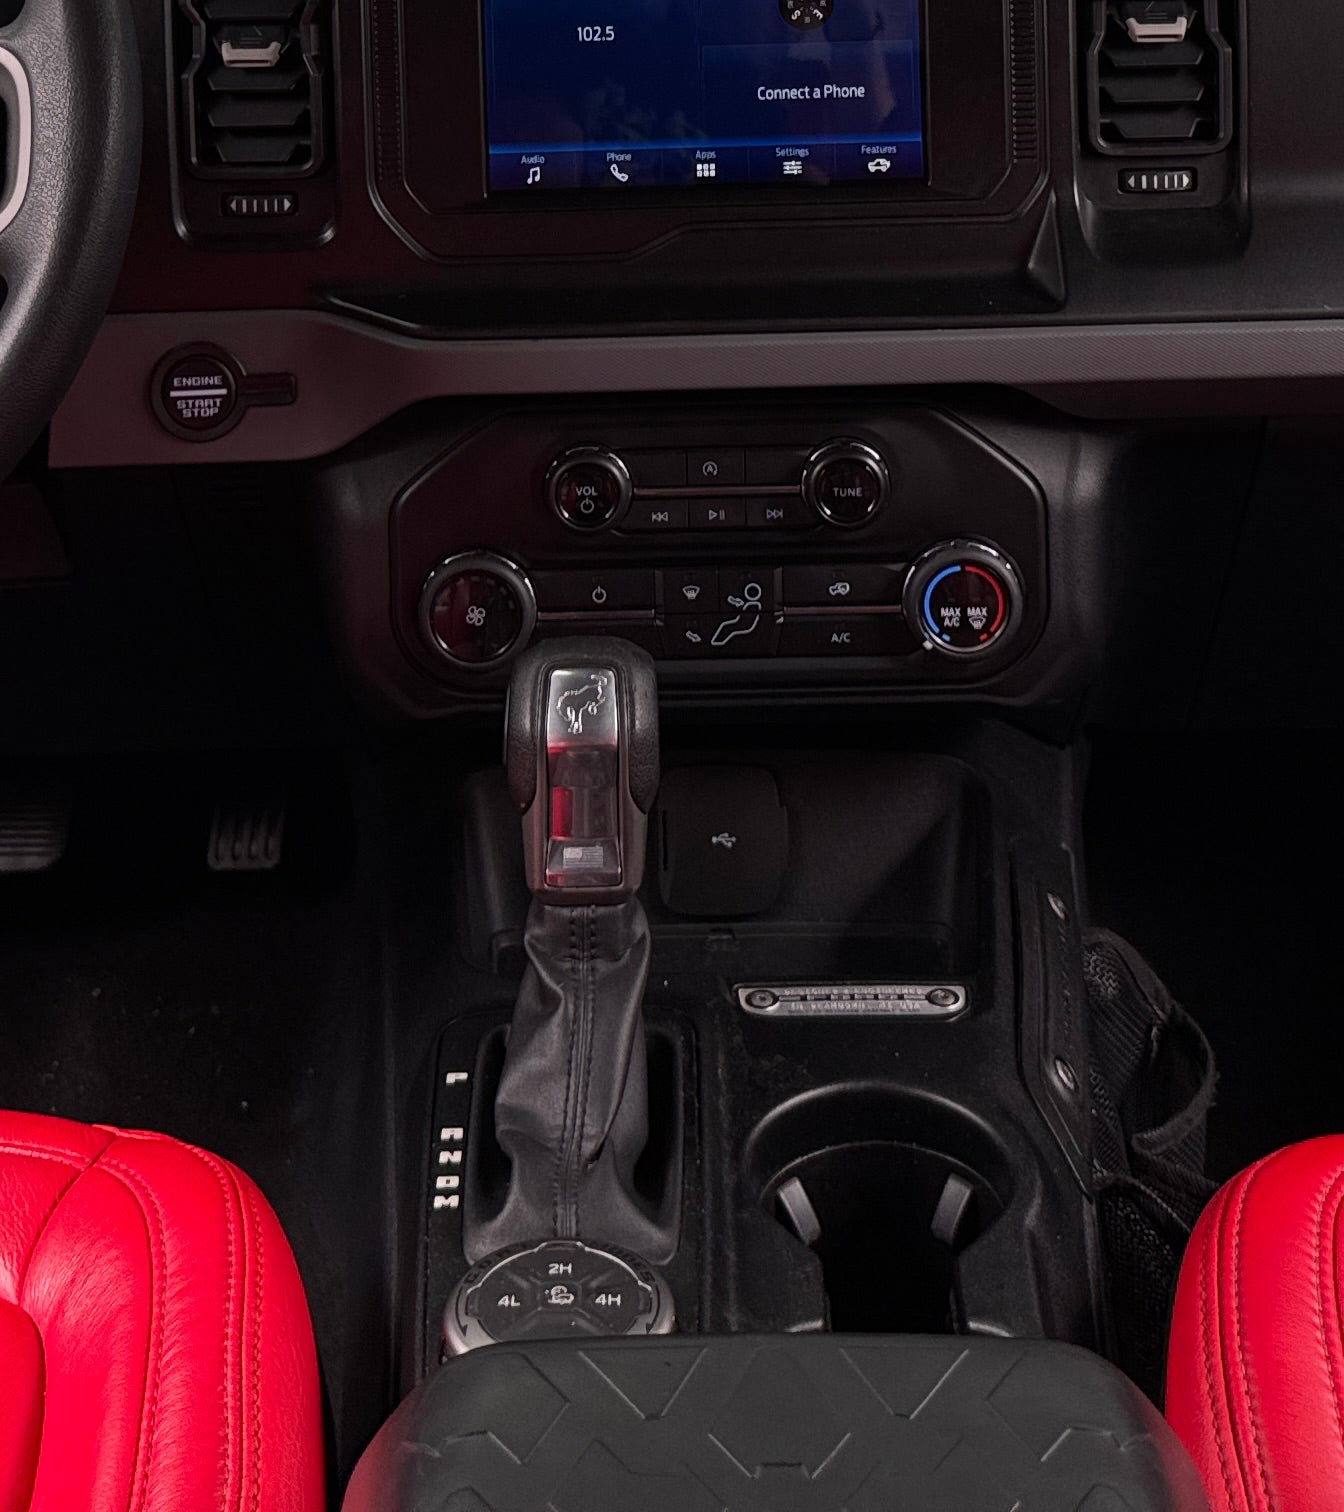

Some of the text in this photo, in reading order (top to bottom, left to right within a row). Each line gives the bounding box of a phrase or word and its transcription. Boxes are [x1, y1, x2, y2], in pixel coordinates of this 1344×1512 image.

[576, 25, 615, 42] 102.5
[757, 83, 866, 101] Connect a Phone
[695, 149, 717, 161] Apps
[774, 146, 810, 159] Settings
[860, 143, 897, 155] Features
[520, 154, 545, 165] Audio
[605, 151, 632, 162] Phone
[173, 375, 223, 388] ENGINE
[176, 397, 223, 410] START
[181, 407, 219, 419] STOP
[575, 486, 598, 497] VOL
[832, 487, 863, 498] TUNE
[940, 606, 962, 617] MAX
[966, 606, 988, 617] MAX
[943, 616, 960, 628] A/C
[830, 632, 851, 644] A/C
[438, 1149, 463, 1164] N
[433, 1194, 460, 1209] M
[548, 1263, 572, 1275] 2H
[497, 1294, 521, 1307] 4L
[594, 1293, 622, 1307] 4H
